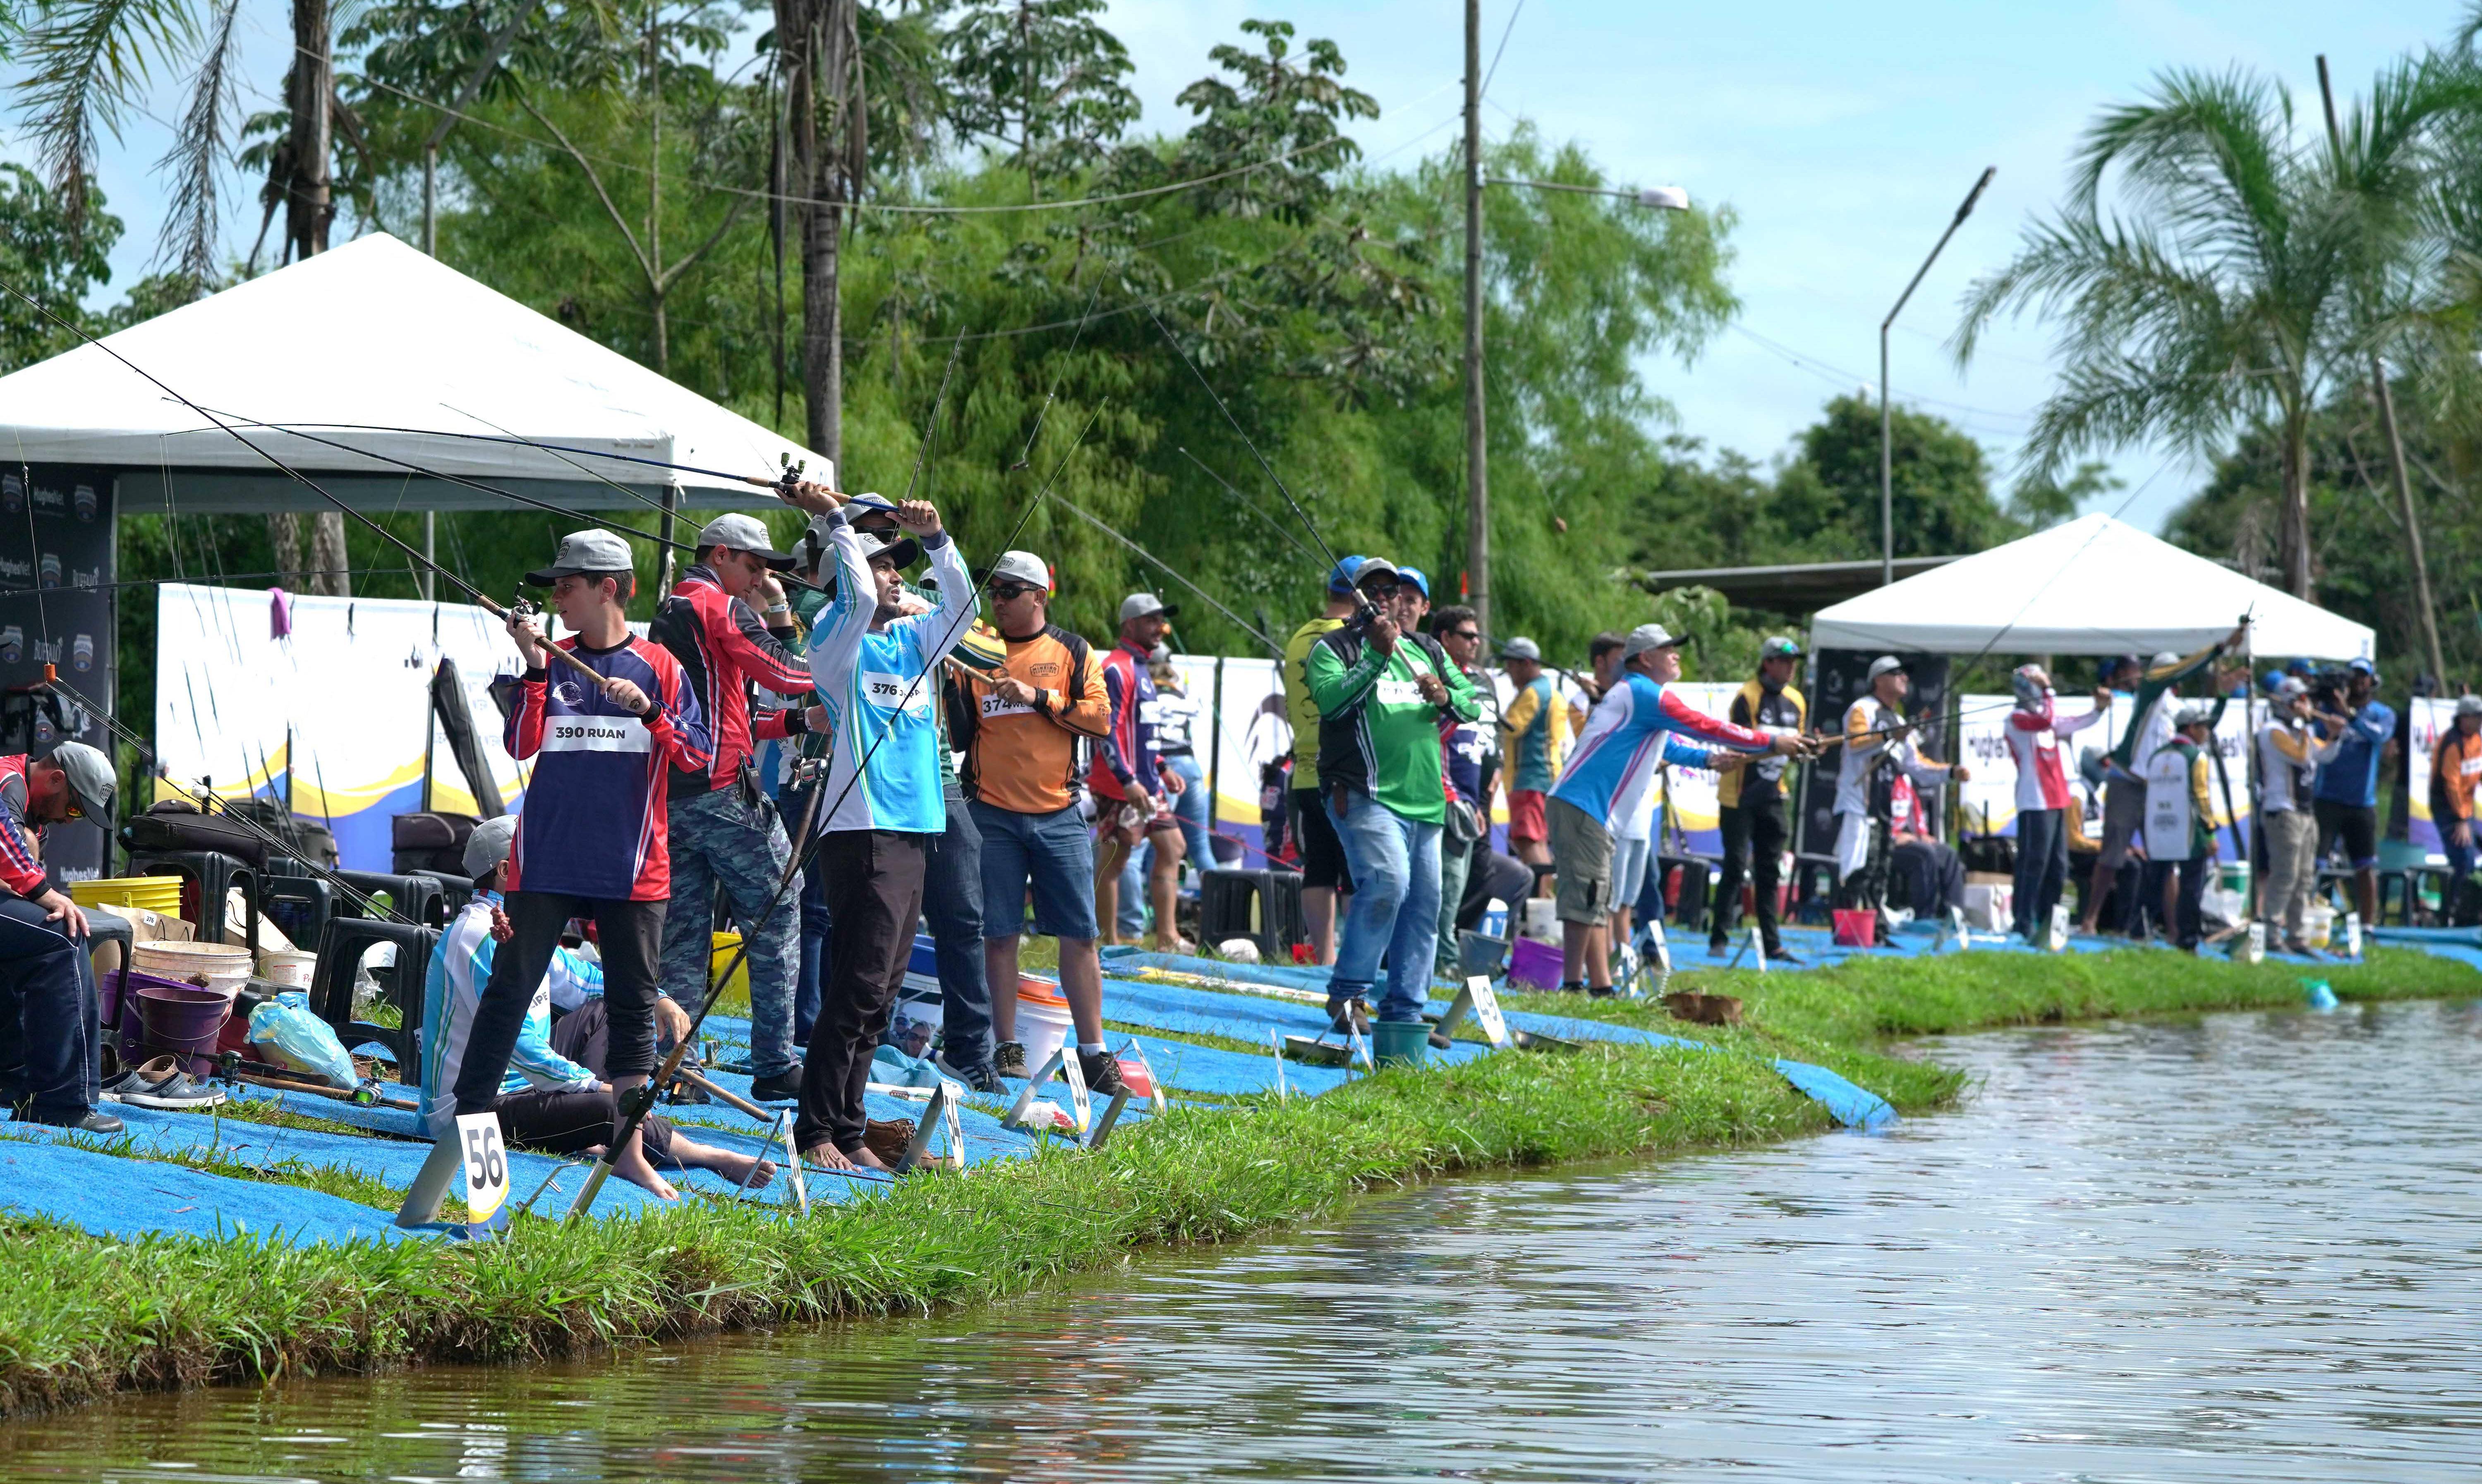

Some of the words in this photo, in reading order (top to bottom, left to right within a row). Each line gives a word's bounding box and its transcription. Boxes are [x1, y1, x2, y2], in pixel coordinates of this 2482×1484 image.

[872, 683, 898, 695] 376
[983, 699, 1012, 713] 374
[556, 727, 584, 738] 390
[587, 728, 625, 739] RUAN
[1477, 987, 1497, 1022] 49
[944, 1094, 961, 1148] 54
[466, 1126, 503, 1190] 56
[785, 1123, 800, 1180] 55
